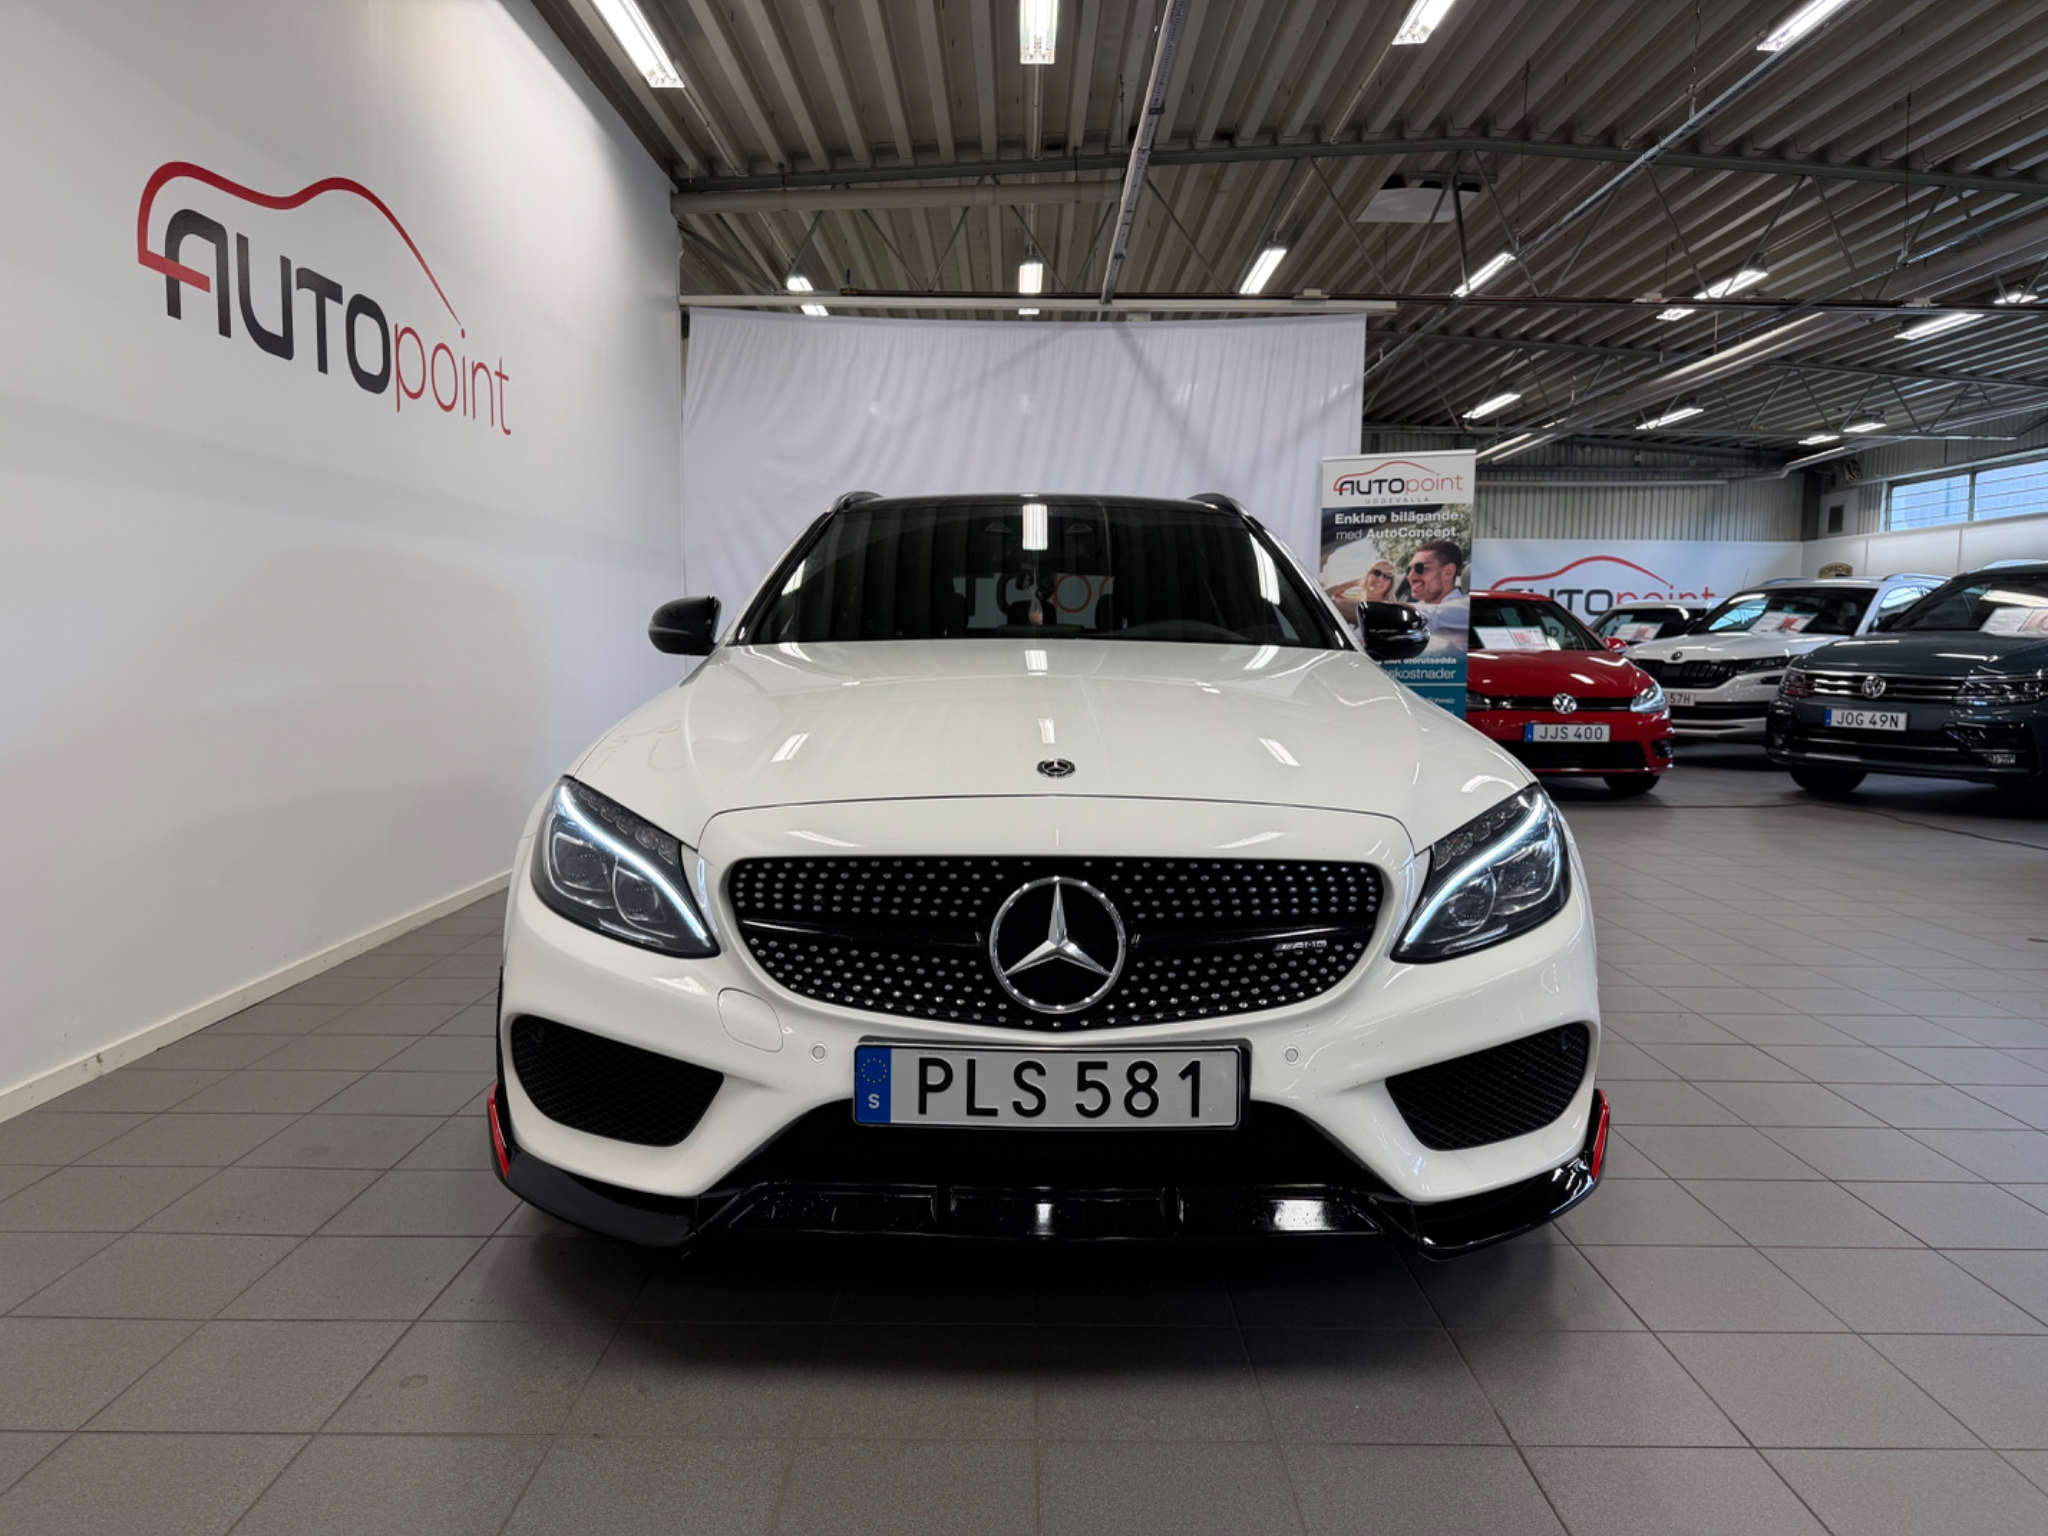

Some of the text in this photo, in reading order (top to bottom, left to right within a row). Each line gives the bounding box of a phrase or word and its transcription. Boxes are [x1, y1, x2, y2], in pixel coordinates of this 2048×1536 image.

[138, 209, 511, 436] AUTOpoint
[1333, 472, 1463, 497] AUTOpoint
[1334, 510, 1459, 525] Enklare bilägande
[1336, 530, 1361, 540] med
[1836, 711, 1899, 728] JOG 49N
[1539, 726, 1603, 740] JJS 400
[867, 1056, 1202, 1119] S PLS 581
